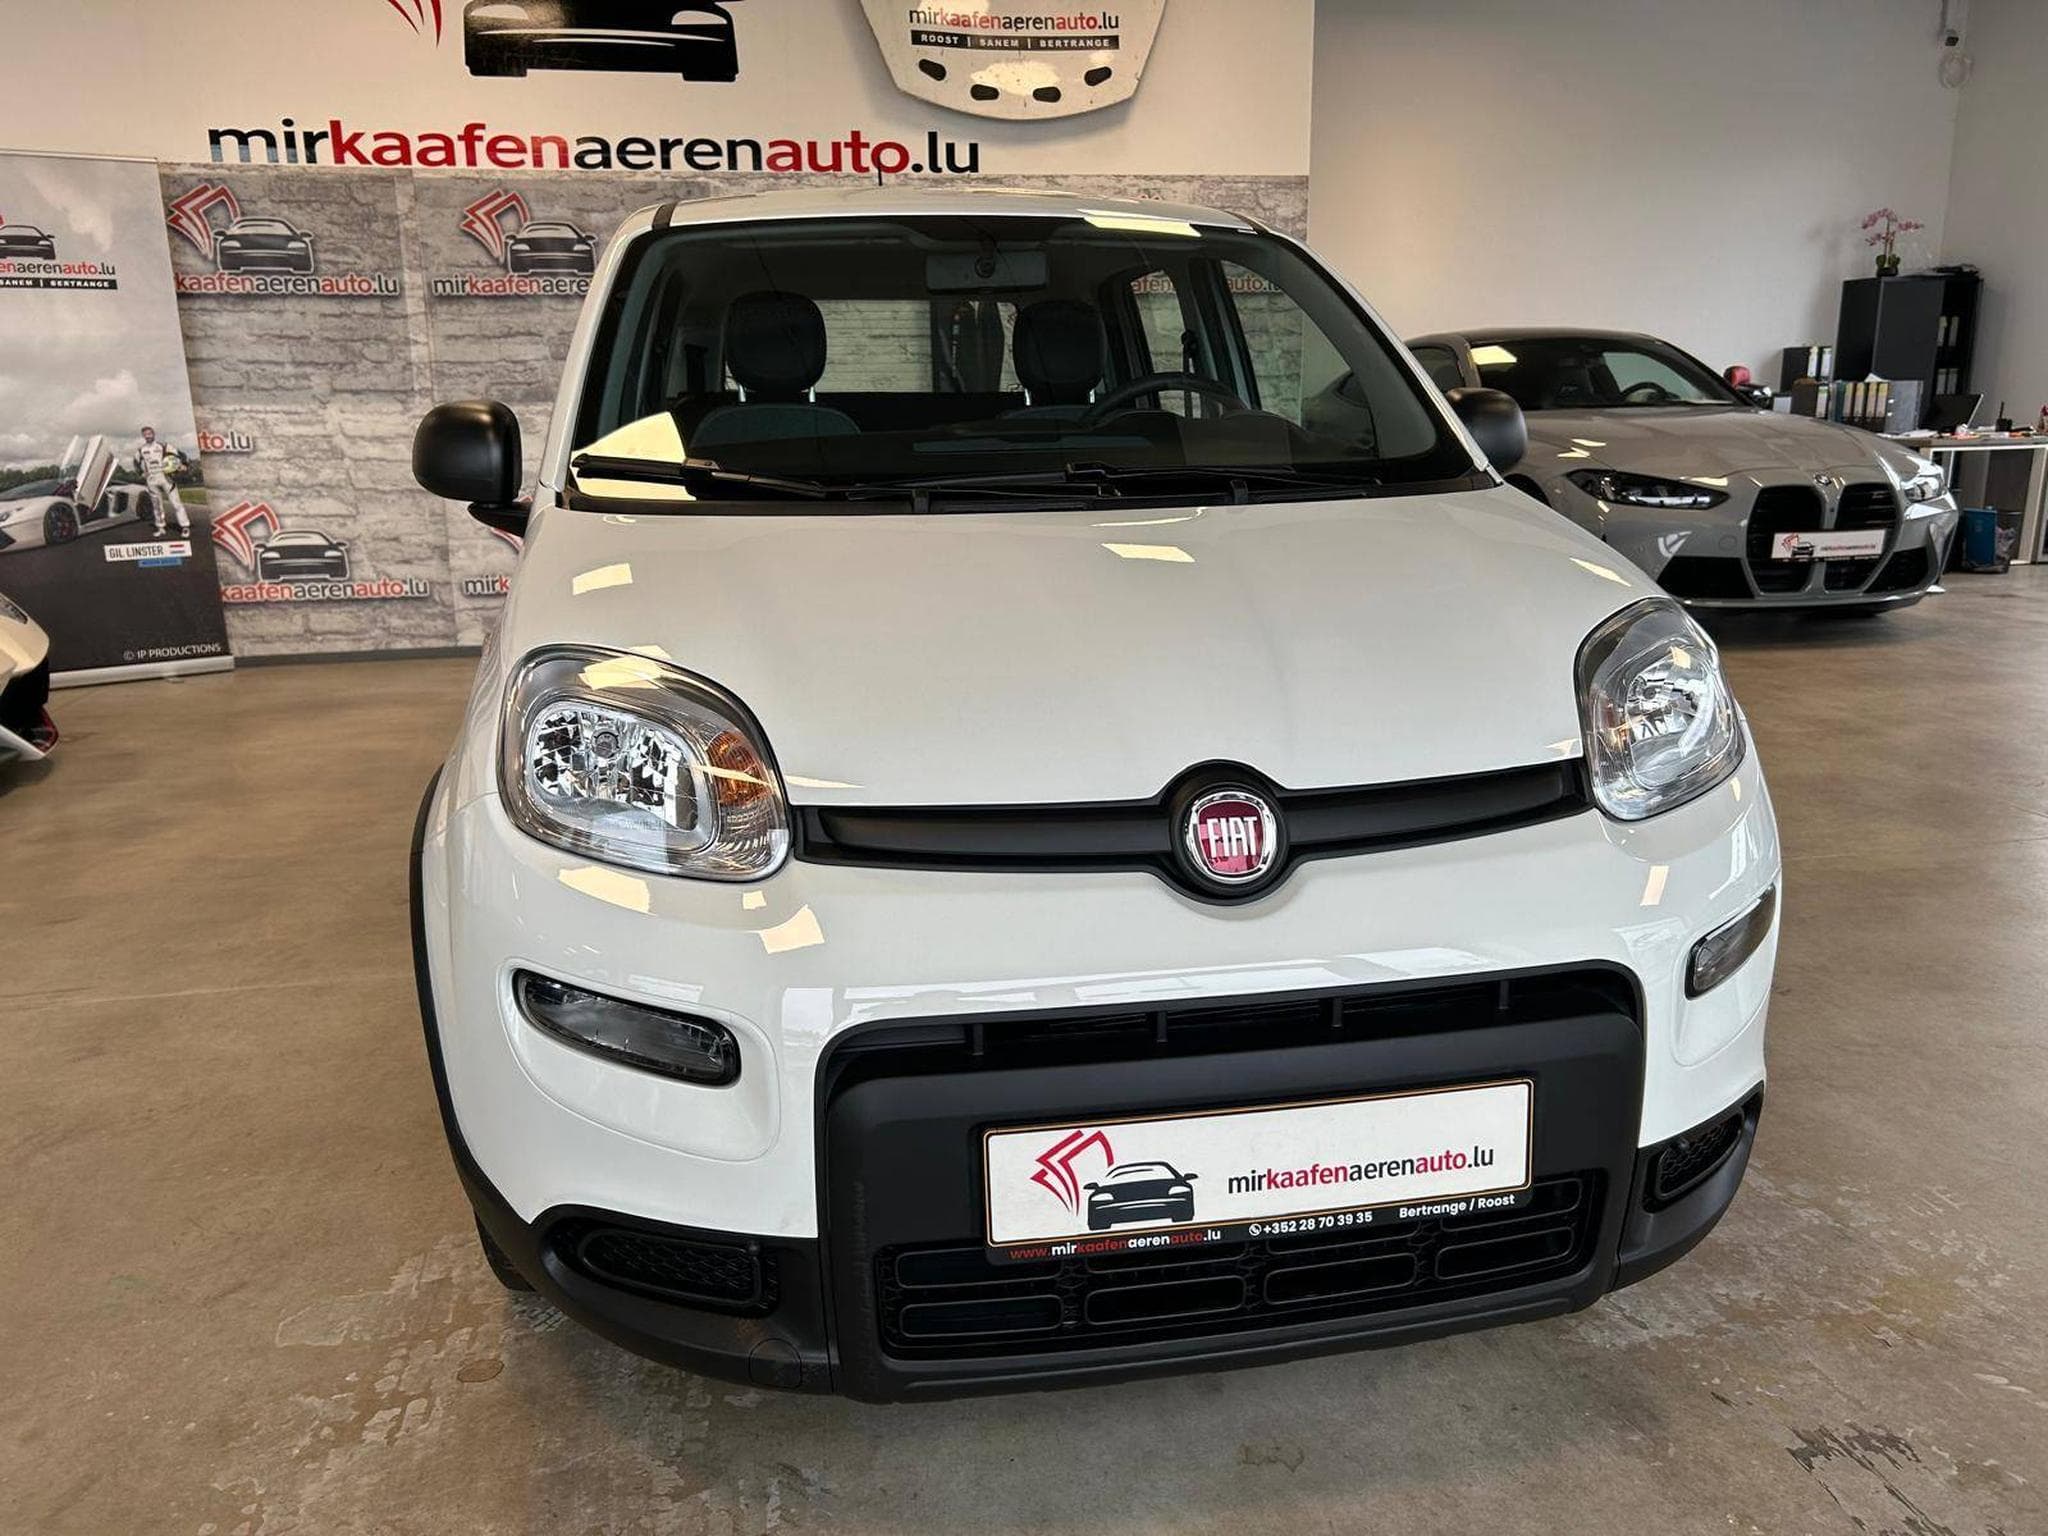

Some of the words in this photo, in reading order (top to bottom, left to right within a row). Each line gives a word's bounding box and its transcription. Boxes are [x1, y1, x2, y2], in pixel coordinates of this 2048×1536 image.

[909, 7, 1119, 31] mirkaafenaerenauto.lu
[921, 34, 959, 45] ROOST
[979, 38, 1020, 47] SANEM
[1039, 39, 1110, 48] BERTRANGE
[208, 118, 980, 174] mirkaafenaerenauto.lu
[434, 274, 592, 294] mirkaafenaere
[109, 548, 124, 559] GIL
[126, 546, 164, 558] LINSTER
[137, 651, 147, 659] IP
[149, 642, 221, 658] PRODUCTIONS
[1206, 815, 1258, 859] FIAT
[1228, 1145, 1494, 1194] mirkaafenaerenauto.lu
[1009, 1229, 1221, 1260] www.mirkaafenaerenauto.lu
[1263, 1219, 1297, 1235] +352
[1300, 1218, 1316, 1231] 28
[1318, 1216, 1336, 1228] 70
[1337, 1213, 1354, 1226] 39
[1356, 1211, 1373, 1224] 35
[1399, 1200, 1467, 1219] Bertrange
[1478, 1194, 1515, 1210] Roost
